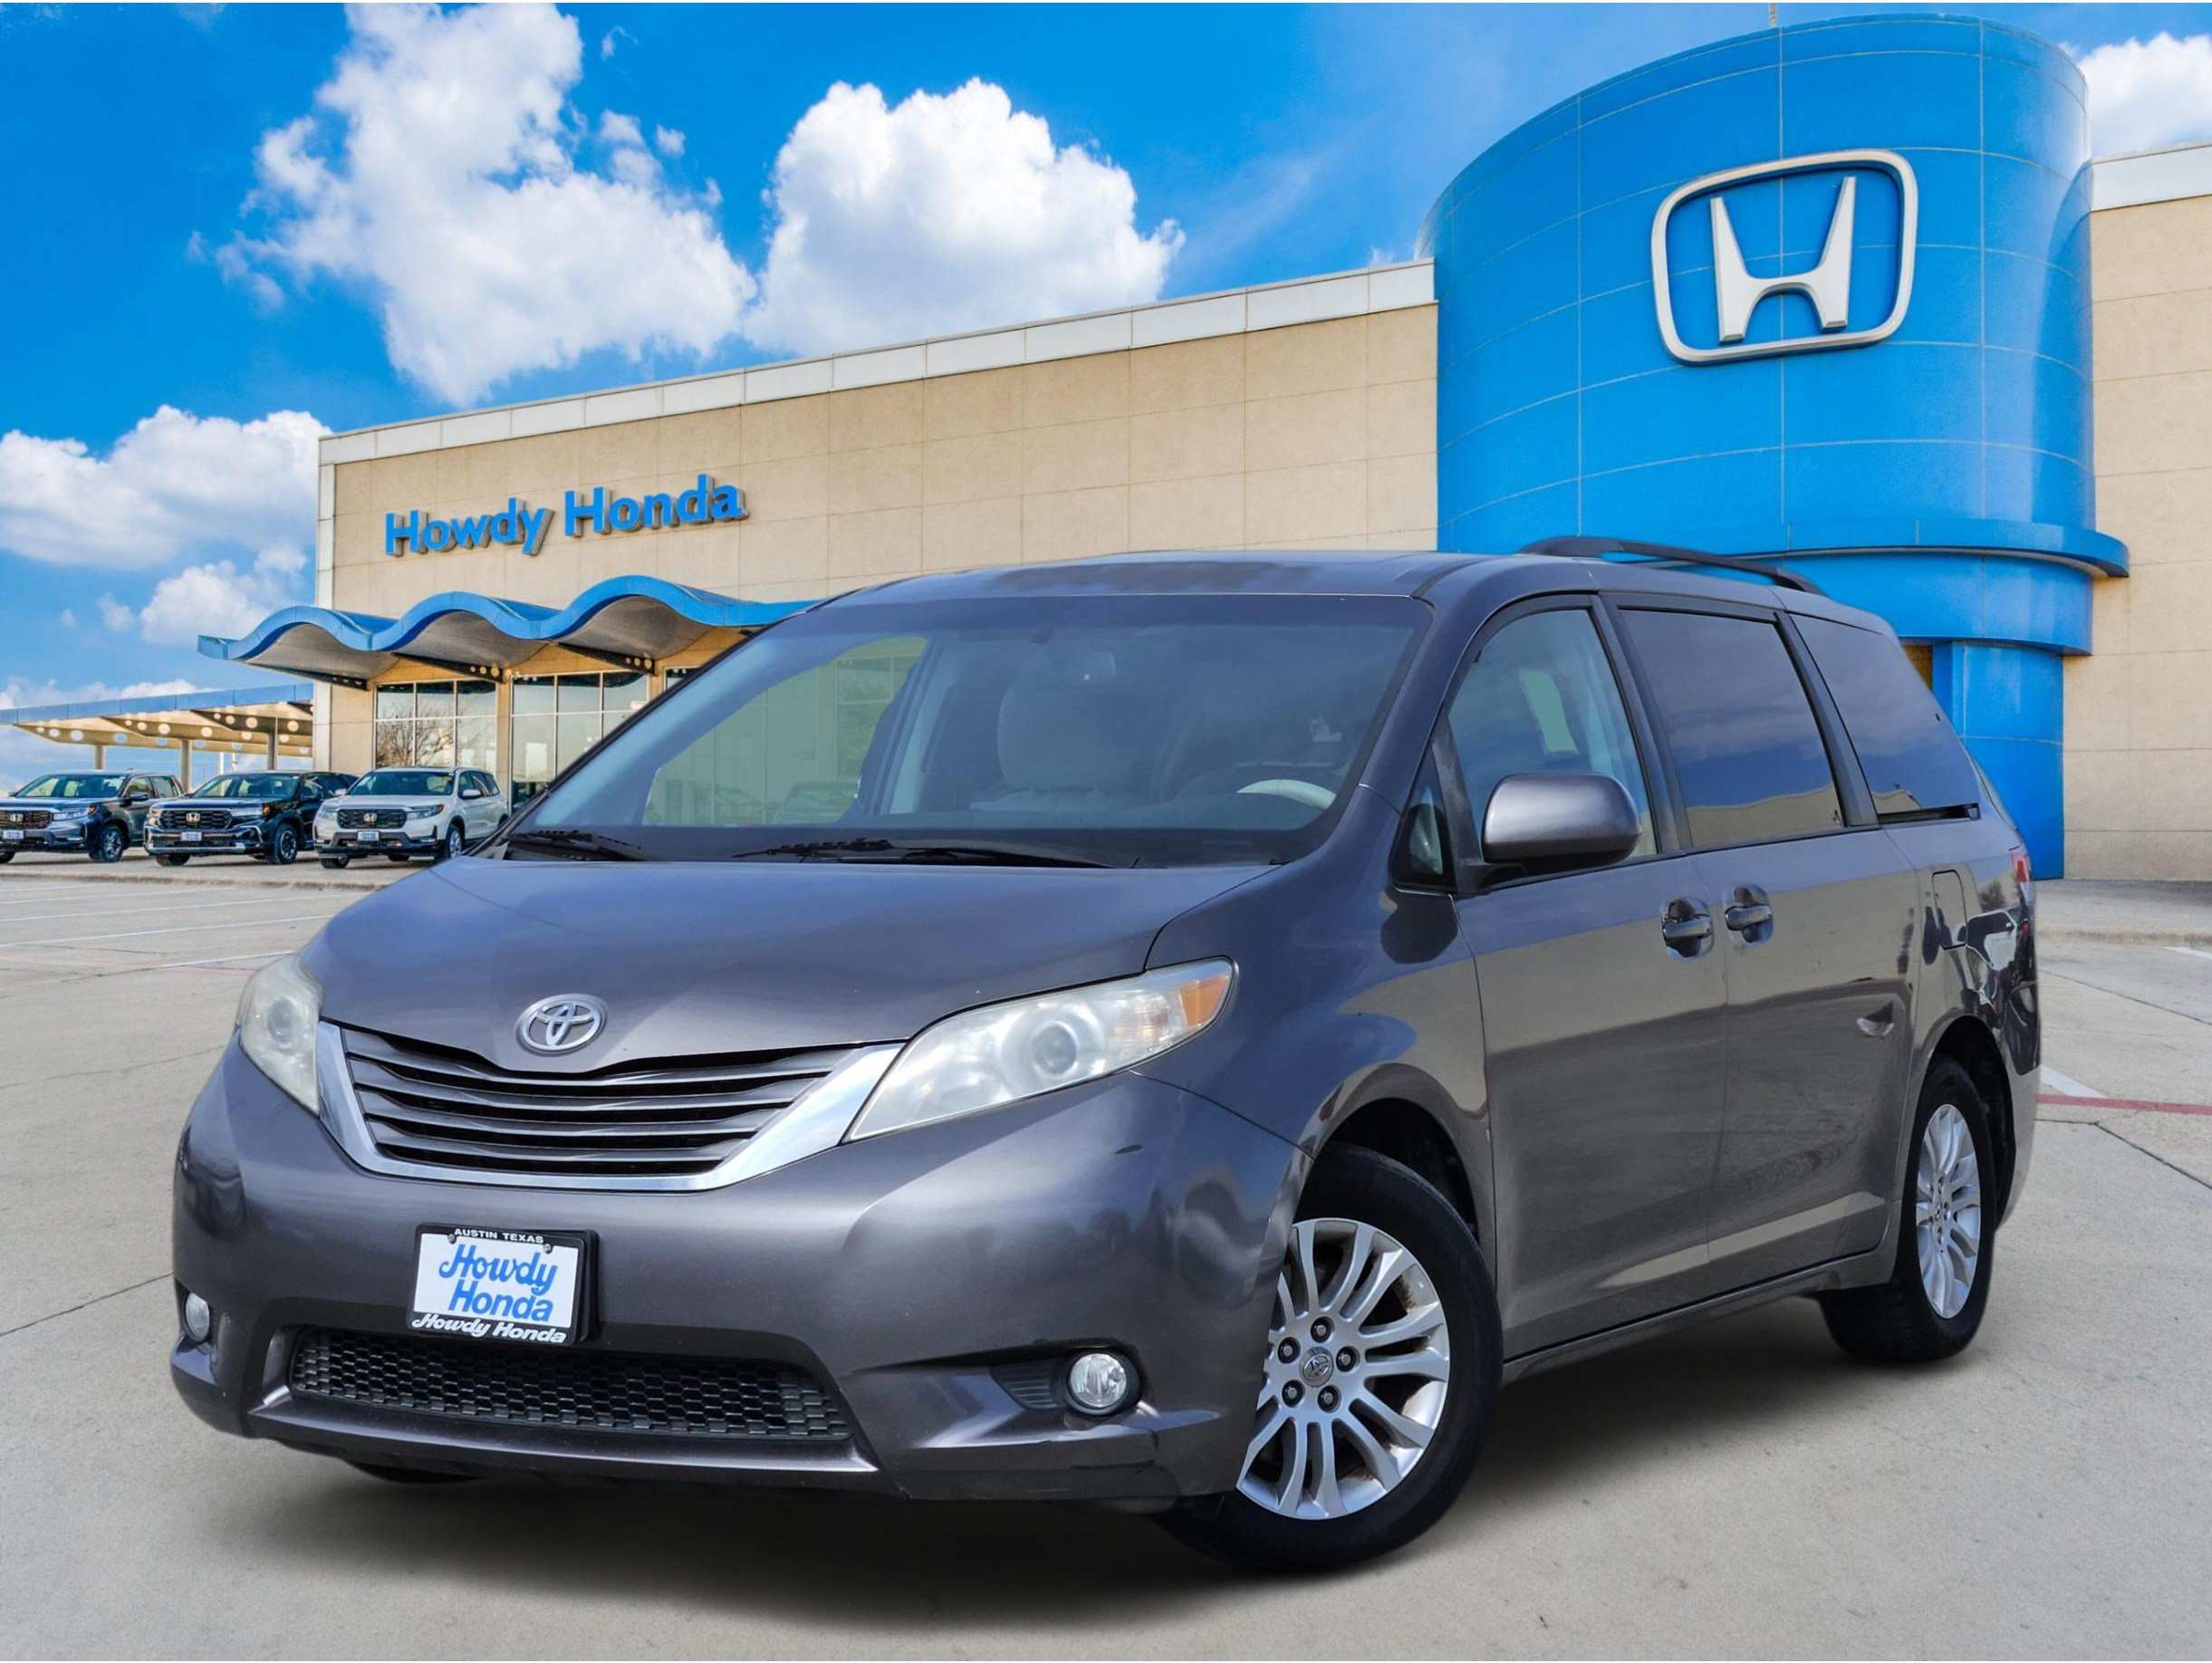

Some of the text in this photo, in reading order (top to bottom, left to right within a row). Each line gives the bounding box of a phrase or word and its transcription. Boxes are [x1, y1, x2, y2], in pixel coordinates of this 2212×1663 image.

[385, 474, 749, 557] Howdy Honda
[454, 1228, 544, 1244] AUSTIN TEXAS
[438, 1244, 558, 1296] Howdy
[448, 1279, 553, 1322] Honda
[411, 1313, 567, 1343] Howdy Honda
